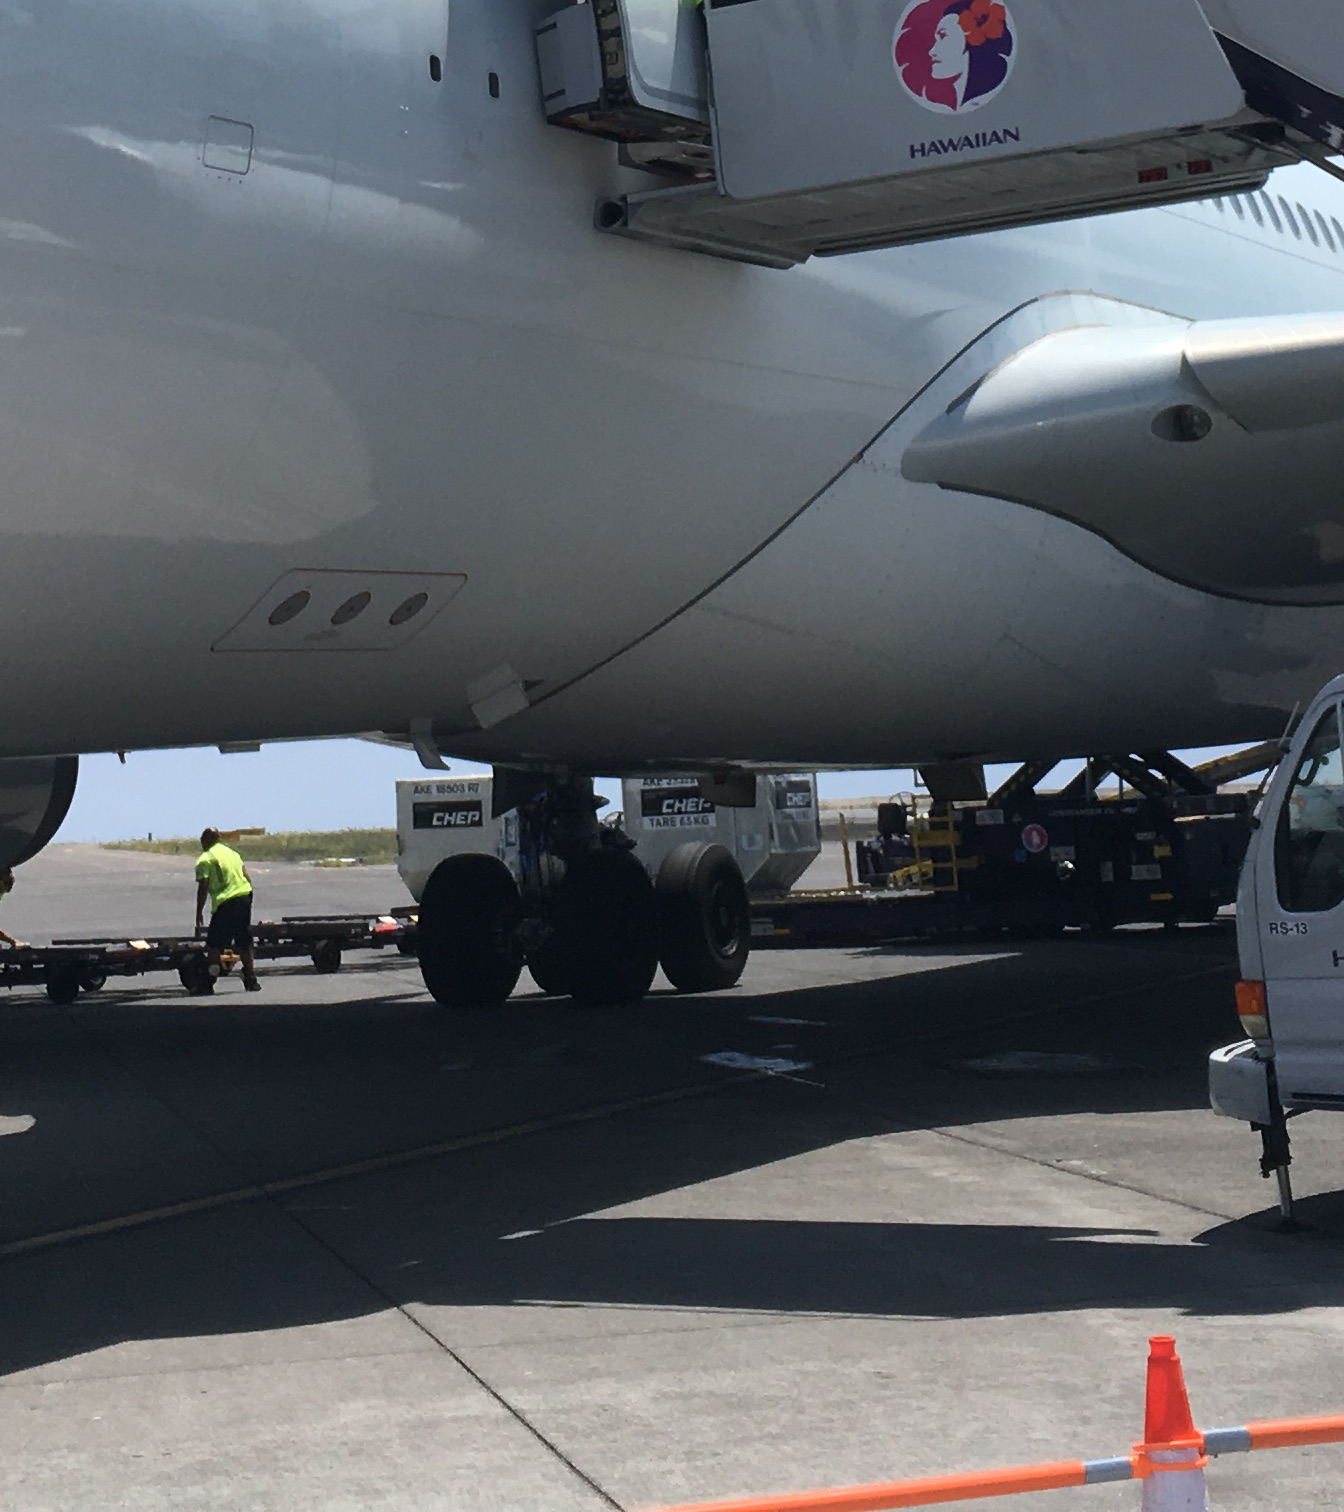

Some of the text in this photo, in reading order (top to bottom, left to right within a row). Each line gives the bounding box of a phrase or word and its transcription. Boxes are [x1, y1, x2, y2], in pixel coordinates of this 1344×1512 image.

[909, 126, 1021, 159] HAWAIIAN
[432, 811, 480, 826] CHEP
[649, 816, 676, 828] TARE
[1268, 922, 1308, 936] RS-13
